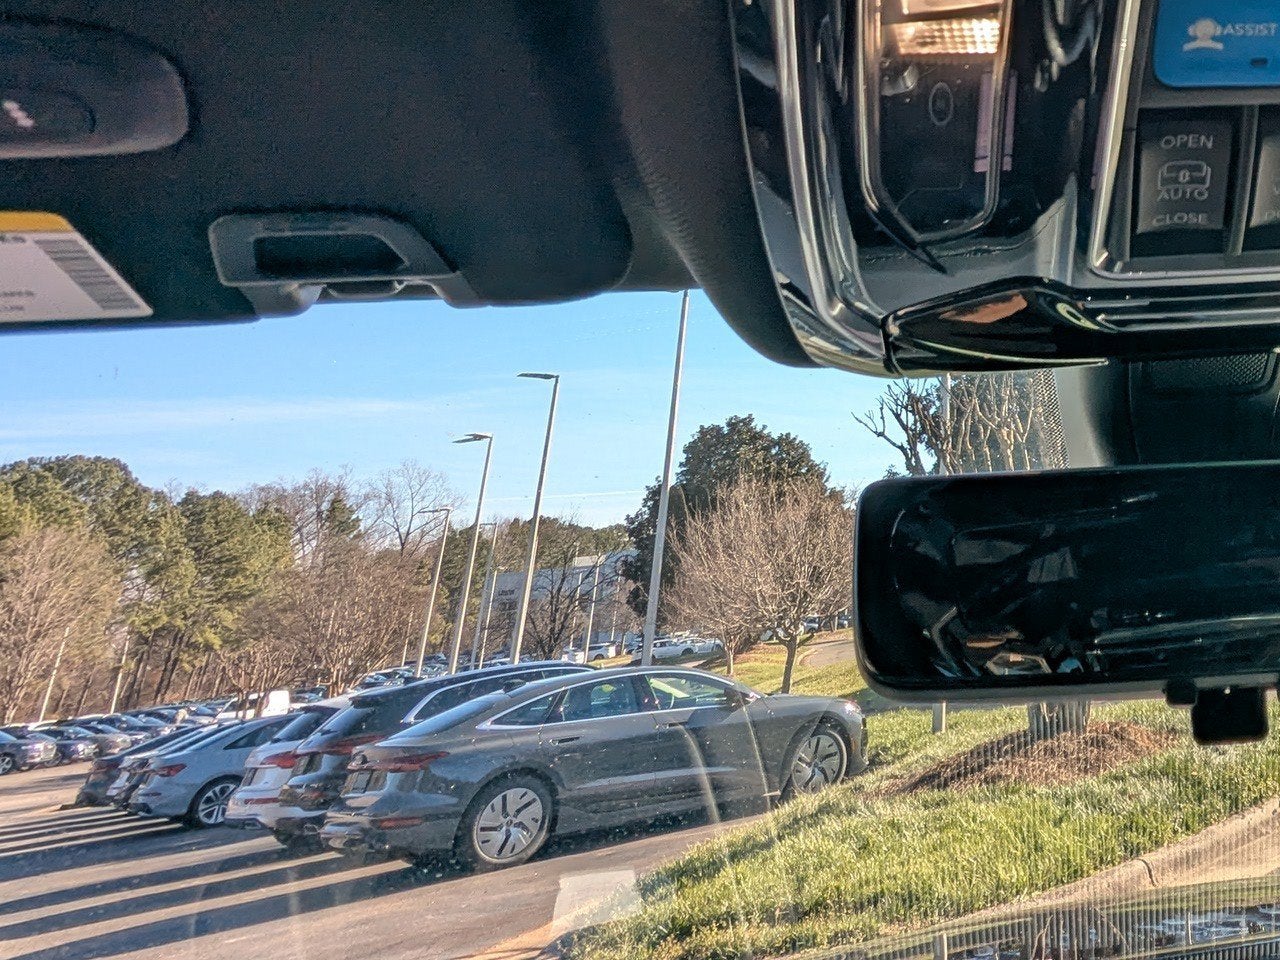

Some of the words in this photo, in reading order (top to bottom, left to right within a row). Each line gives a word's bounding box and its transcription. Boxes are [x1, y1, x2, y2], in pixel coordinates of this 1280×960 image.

[1223, 22, 1278, 36] ASSIST
[1161, 134, 1214, 150] OPEN
[1157, 189, 1209, 202] AUTO
[1152, 212, 1209, 227] CLOSE
